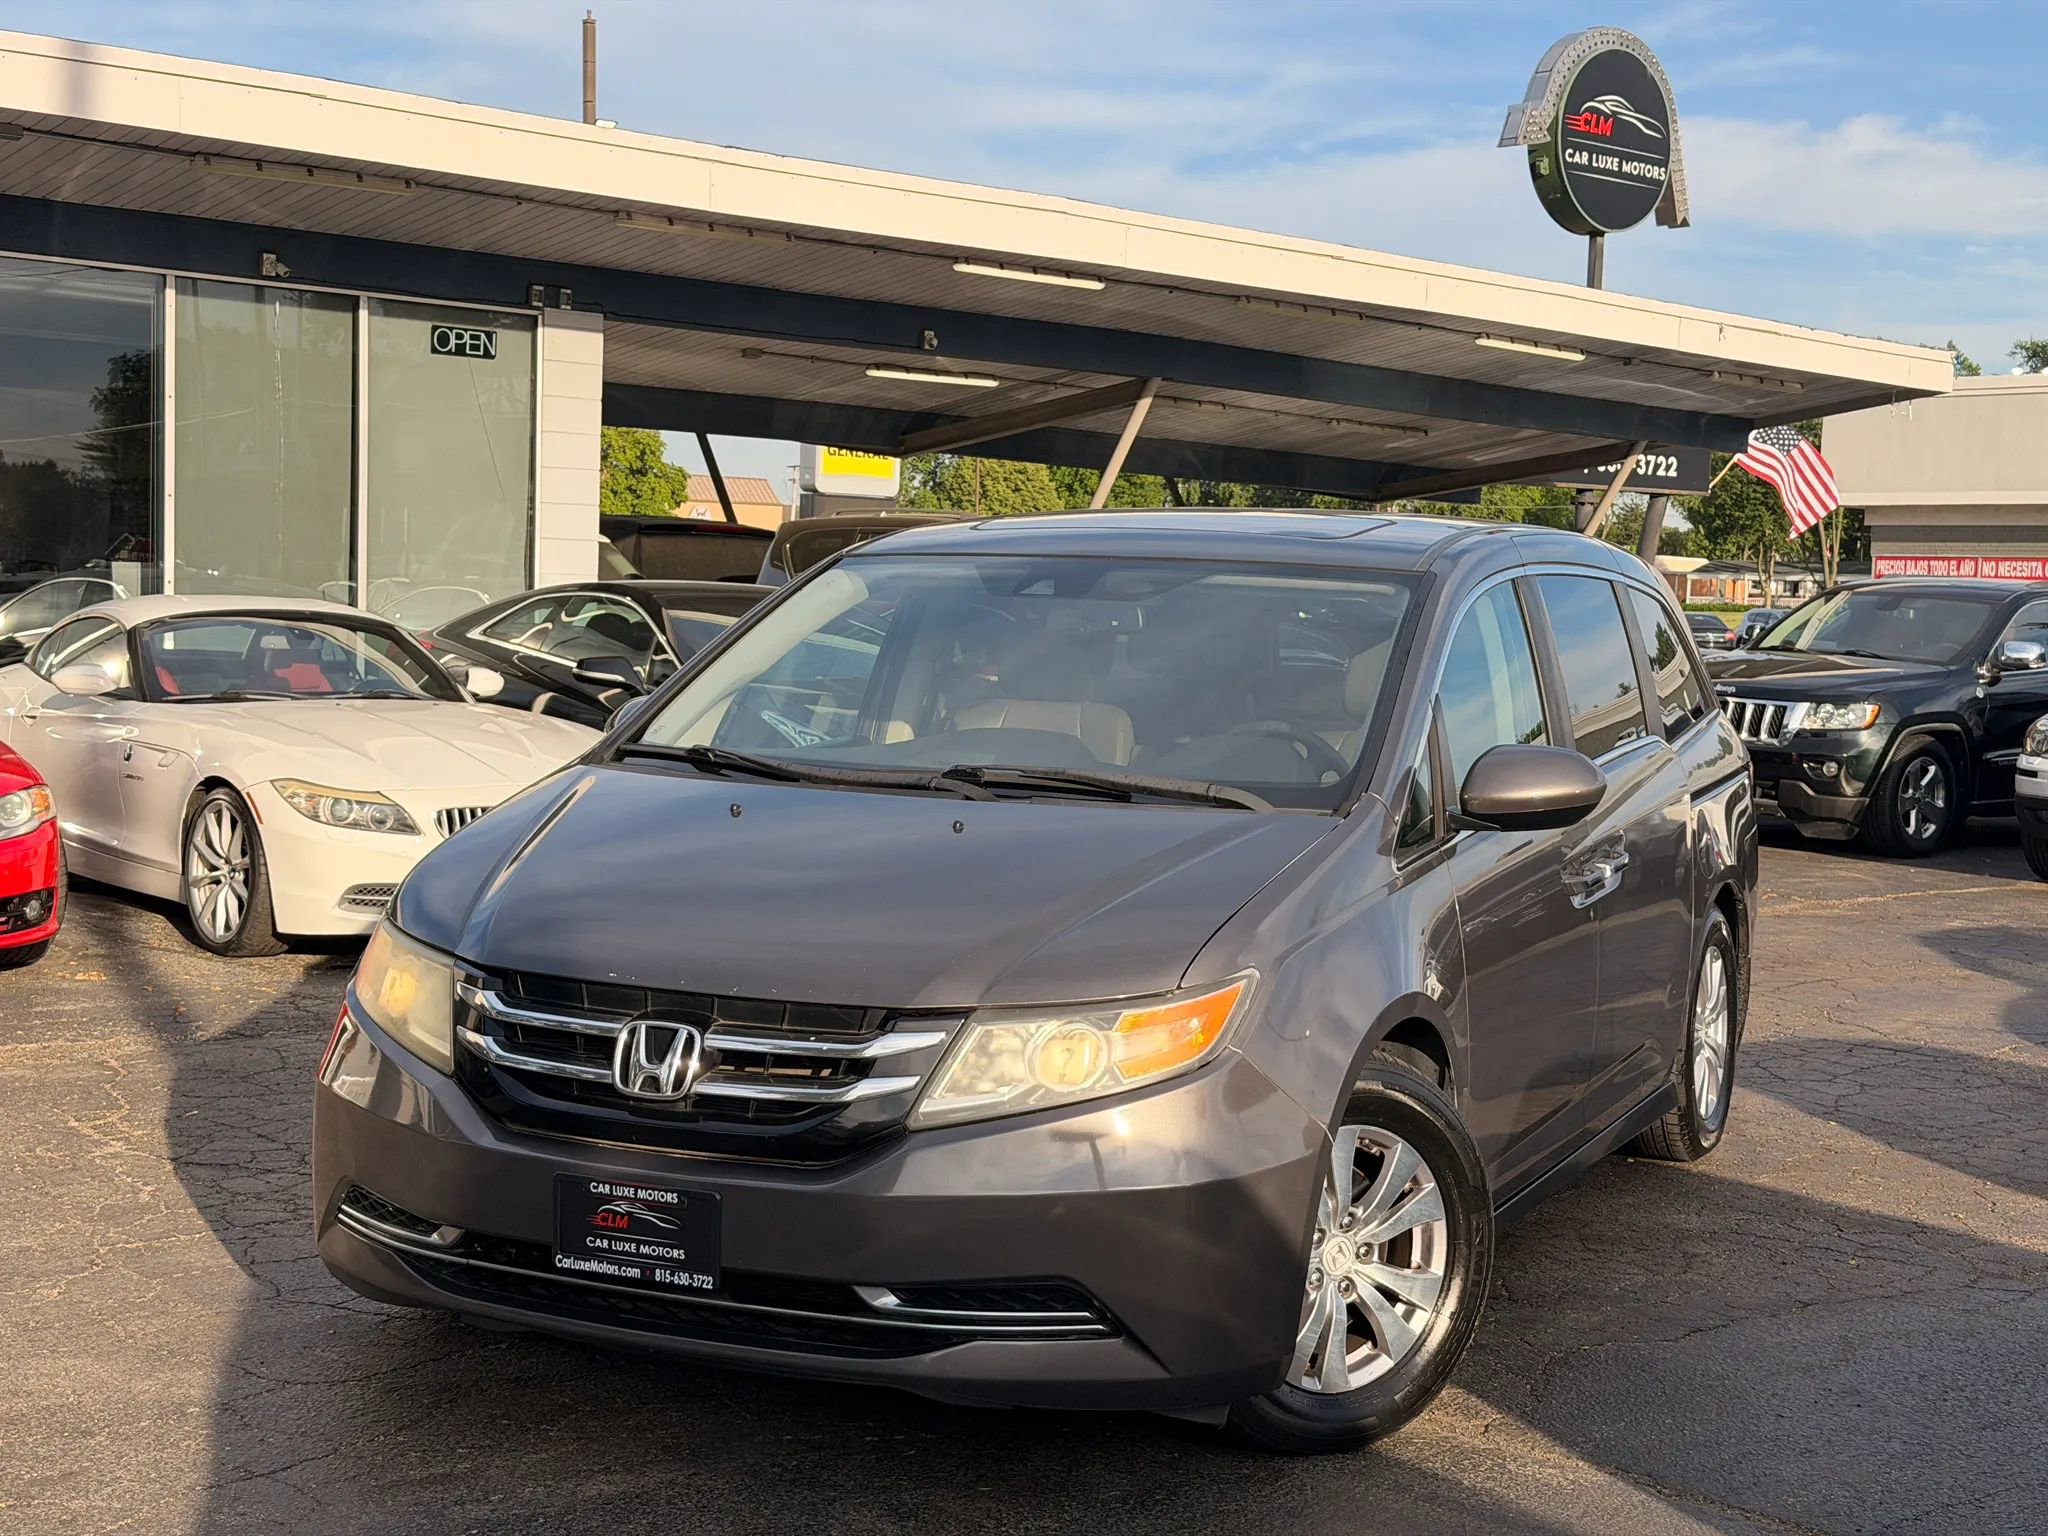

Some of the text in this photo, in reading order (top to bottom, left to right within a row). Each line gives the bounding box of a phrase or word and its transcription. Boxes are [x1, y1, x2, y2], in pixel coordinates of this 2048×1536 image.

[1579, 112, 1614, 137] CLM
[1564, 148, 1667, 181] CAR LUXE MOTORS
[433, 327, 497, 356] OPEN
[826, 447, 890, 461] GENE
[1876, 558, 1975, 577] PRECIOS BAJOS TODO EL AÑO
[1982, 560, 1996, 578] NO
[1998, 560, 2043, 578] NECESITA
[589, 1182, 679, 1204] CAR LUXE MOTORS
[598, 1212, 629, 1229] CLM
[585, 1236, 686, 1260] CAR LUXE MOTORS
[555, 1254, 714, 1290] CarLuxeMotors.com 815-630-3722
